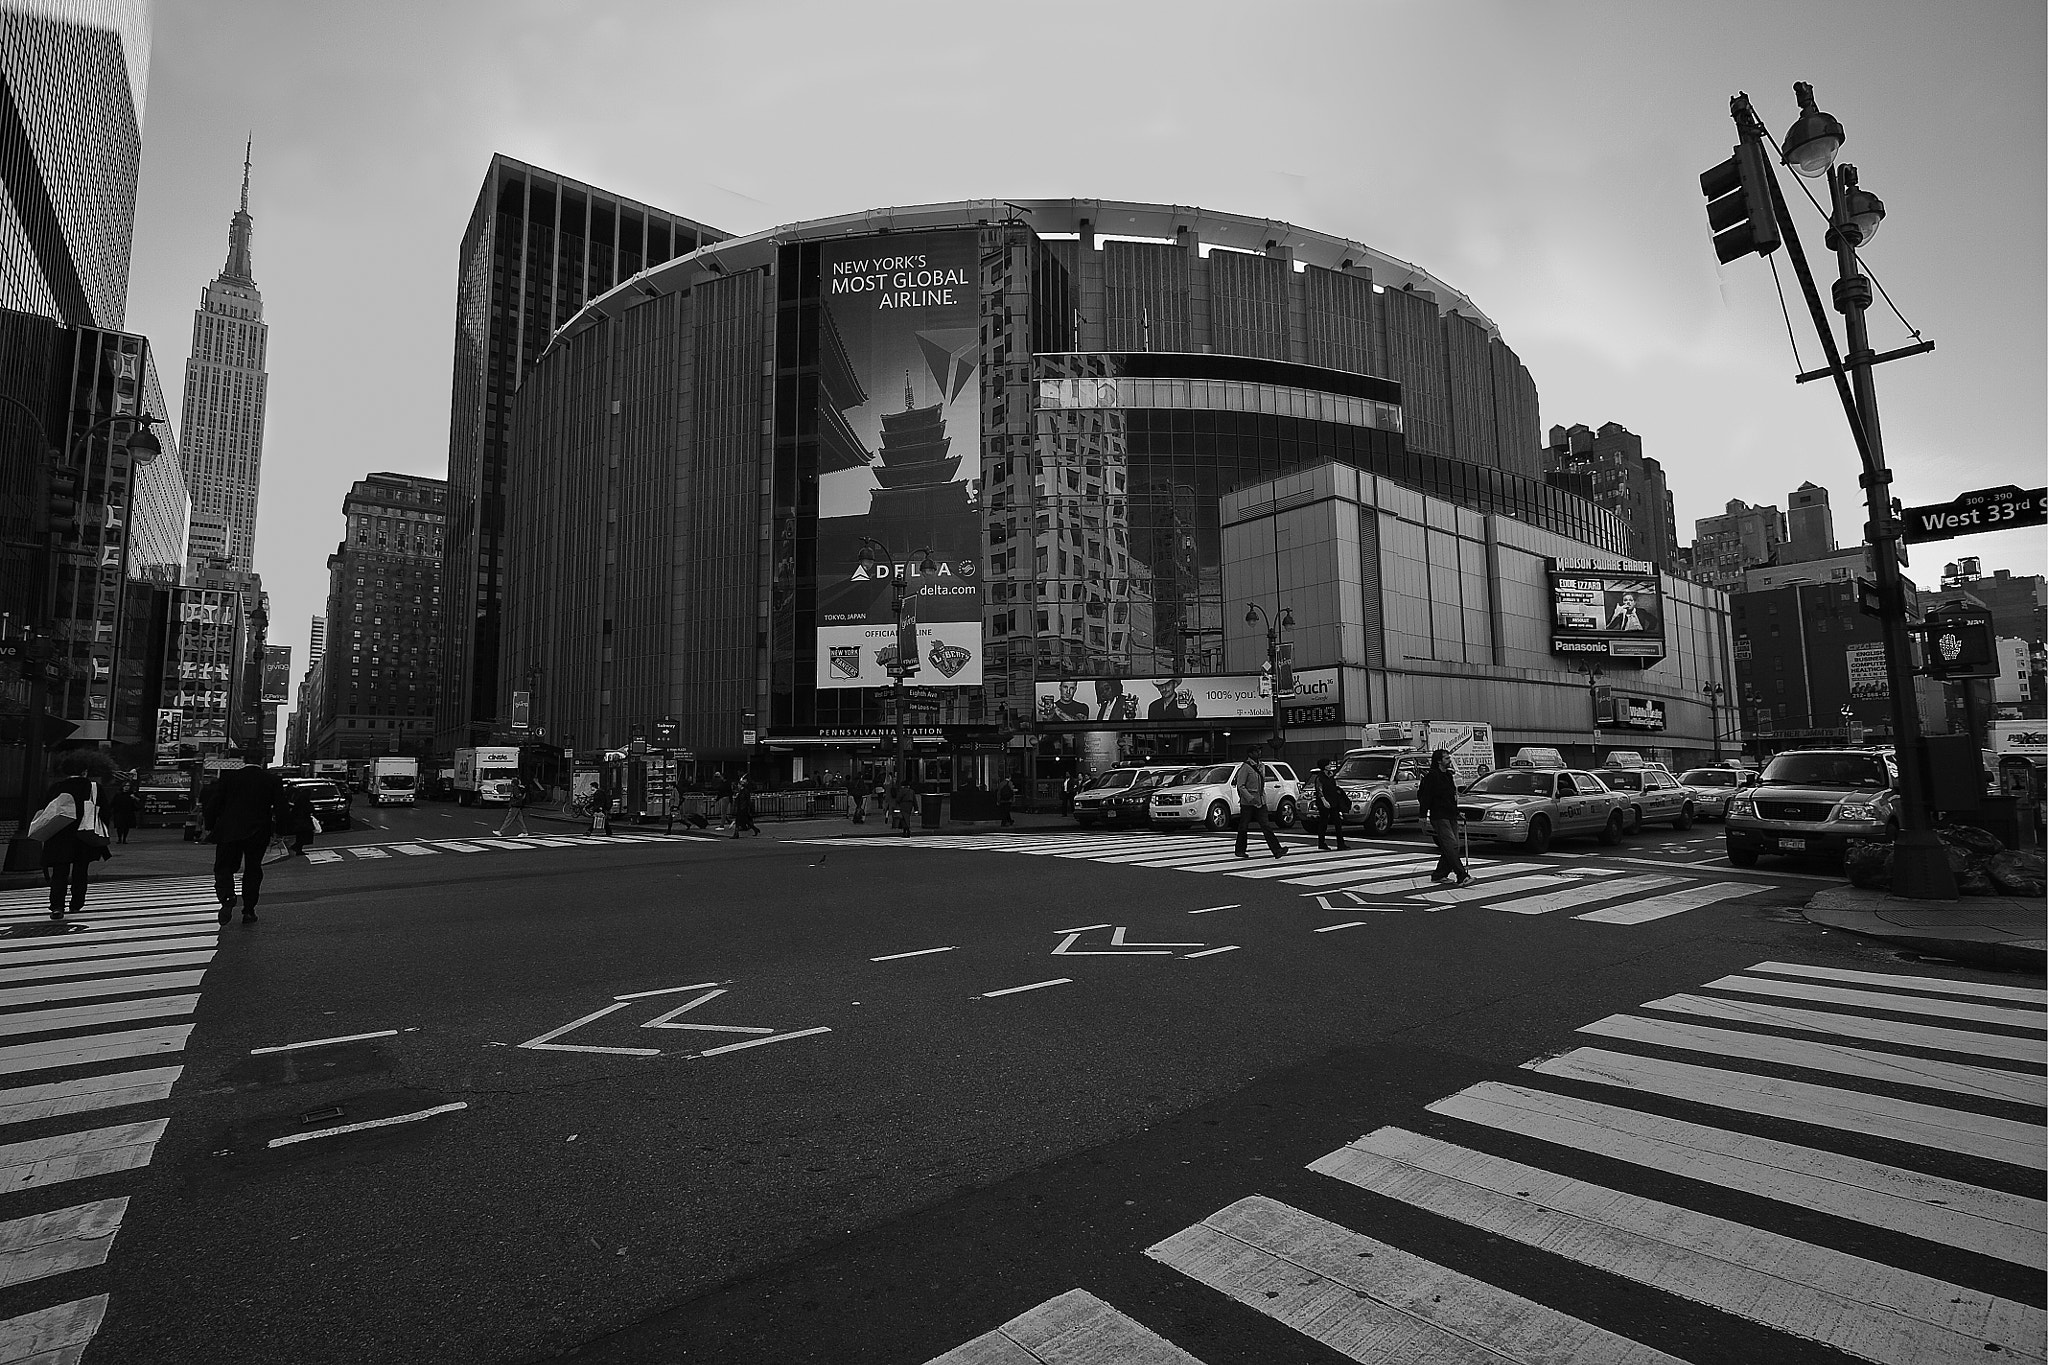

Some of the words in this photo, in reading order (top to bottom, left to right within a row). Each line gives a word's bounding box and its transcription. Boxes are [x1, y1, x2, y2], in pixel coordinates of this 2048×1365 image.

[833, 259, 869, 275] NEW
[873, 254, 927, 271] YORK'S
[831, 273, 888, 294] MOST
[893, 268, 969, 288] GLOBAL
[878, 289, 958, 310] AIRLINE.
[1965, 496, 1984, 506] 300
[1993, 492, 2012, 502] 390
[1921, 509, 1981, 531] West
[1987, 498, 2031, 522] 33rd
[876, 562, 951, 579] DELA
[1556, 557, 1591, 571] MADISON
[1592, 559, 1622, 571] SQUARE
[1623, 560, 1653, 575] GARDEN
[919, 585, 976, 596] delta.com
[1559, 579, 1577, 588] EDDIE
[1577, 581, 1602, 590] IZZARD
[824, 614, 847, 622] TOKYO,
[0, 646, 17, 656] ve
[1555, 641, 1608, 652] Panasonic
[835, 657, 858, 677] RANGERS
[909, 689, 927, 698] Eighth
[1206, 690, 1232, 700] 100%
[1294, 679, 1328, 695] ouch
[1287, 706, 1336, 724] 10:09
[159, 711, 171, 744] PARK
